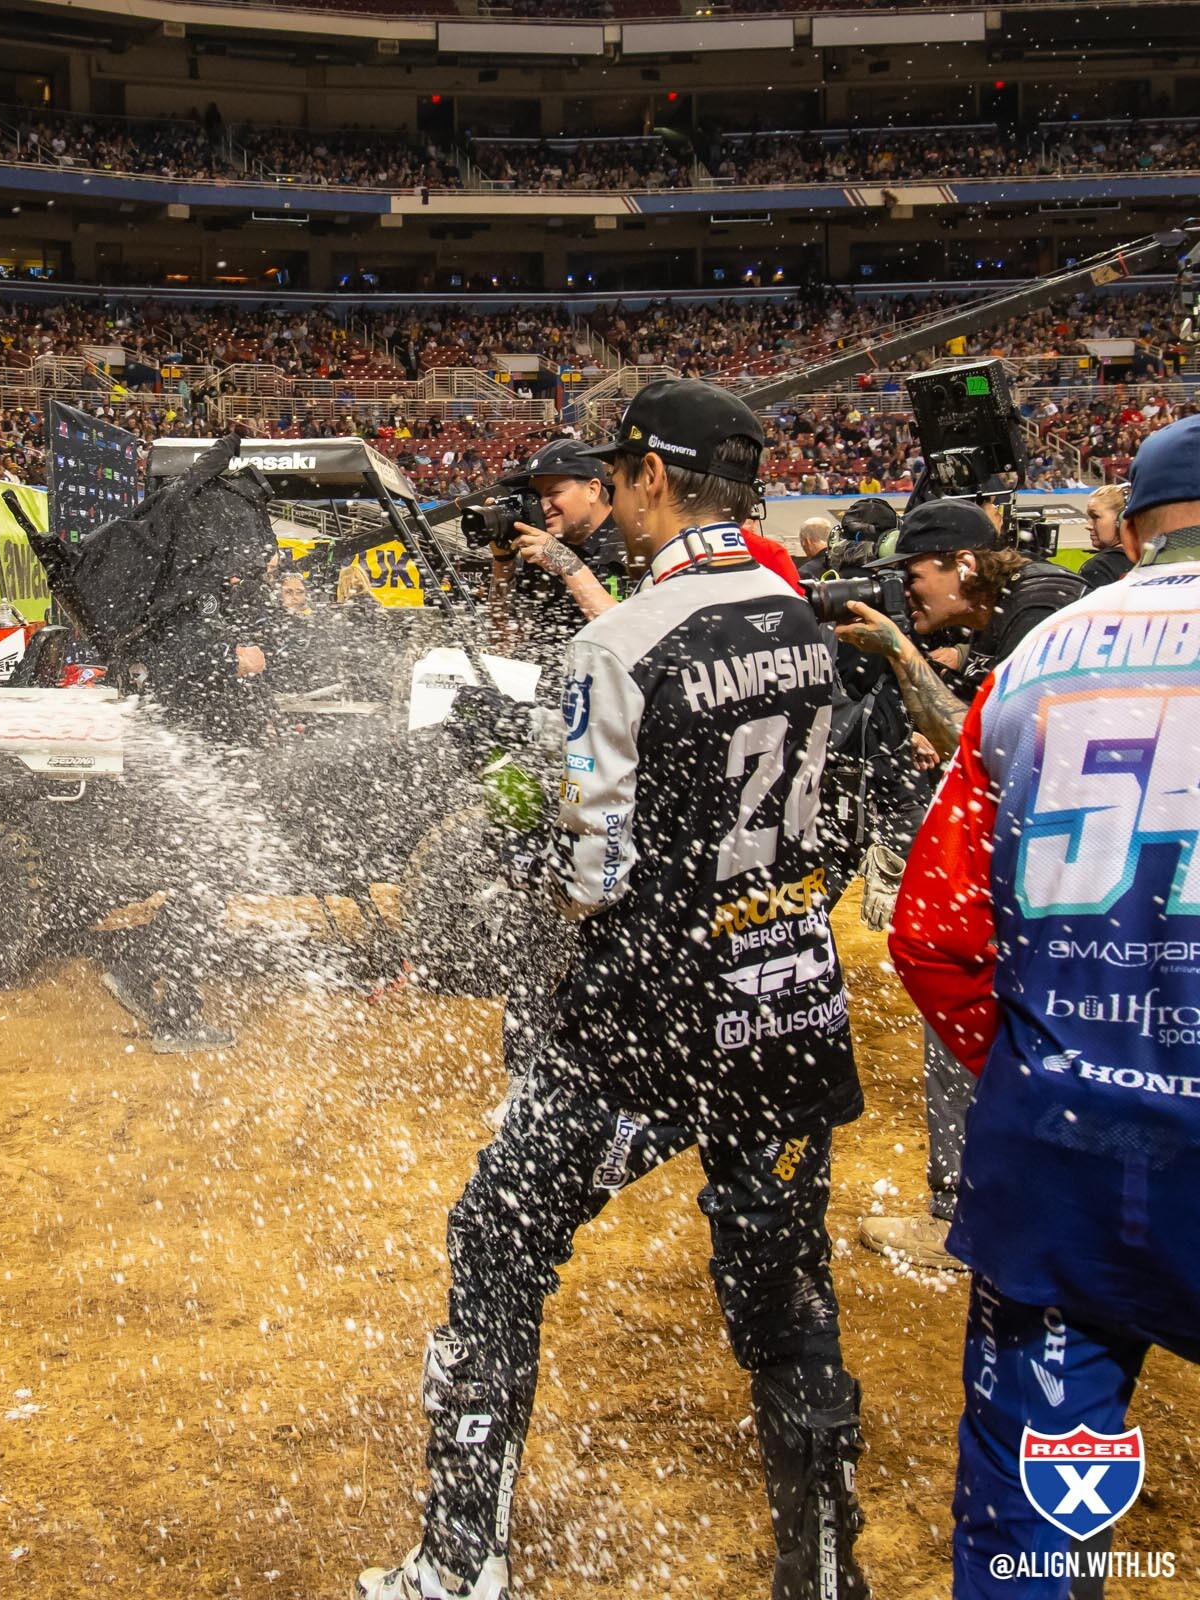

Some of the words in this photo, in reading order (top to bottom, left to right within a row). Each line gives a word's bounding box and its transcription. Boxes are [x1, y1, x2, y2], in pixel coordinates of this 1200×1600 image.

[657, 439, 697, 456] Husqvarna
[47, 755, 96, 768] SEDONA
[715, 703, 833, 882] 24
[731, 921, 795, 956] ENERGY
[455, 1414, 492, 1443] G
